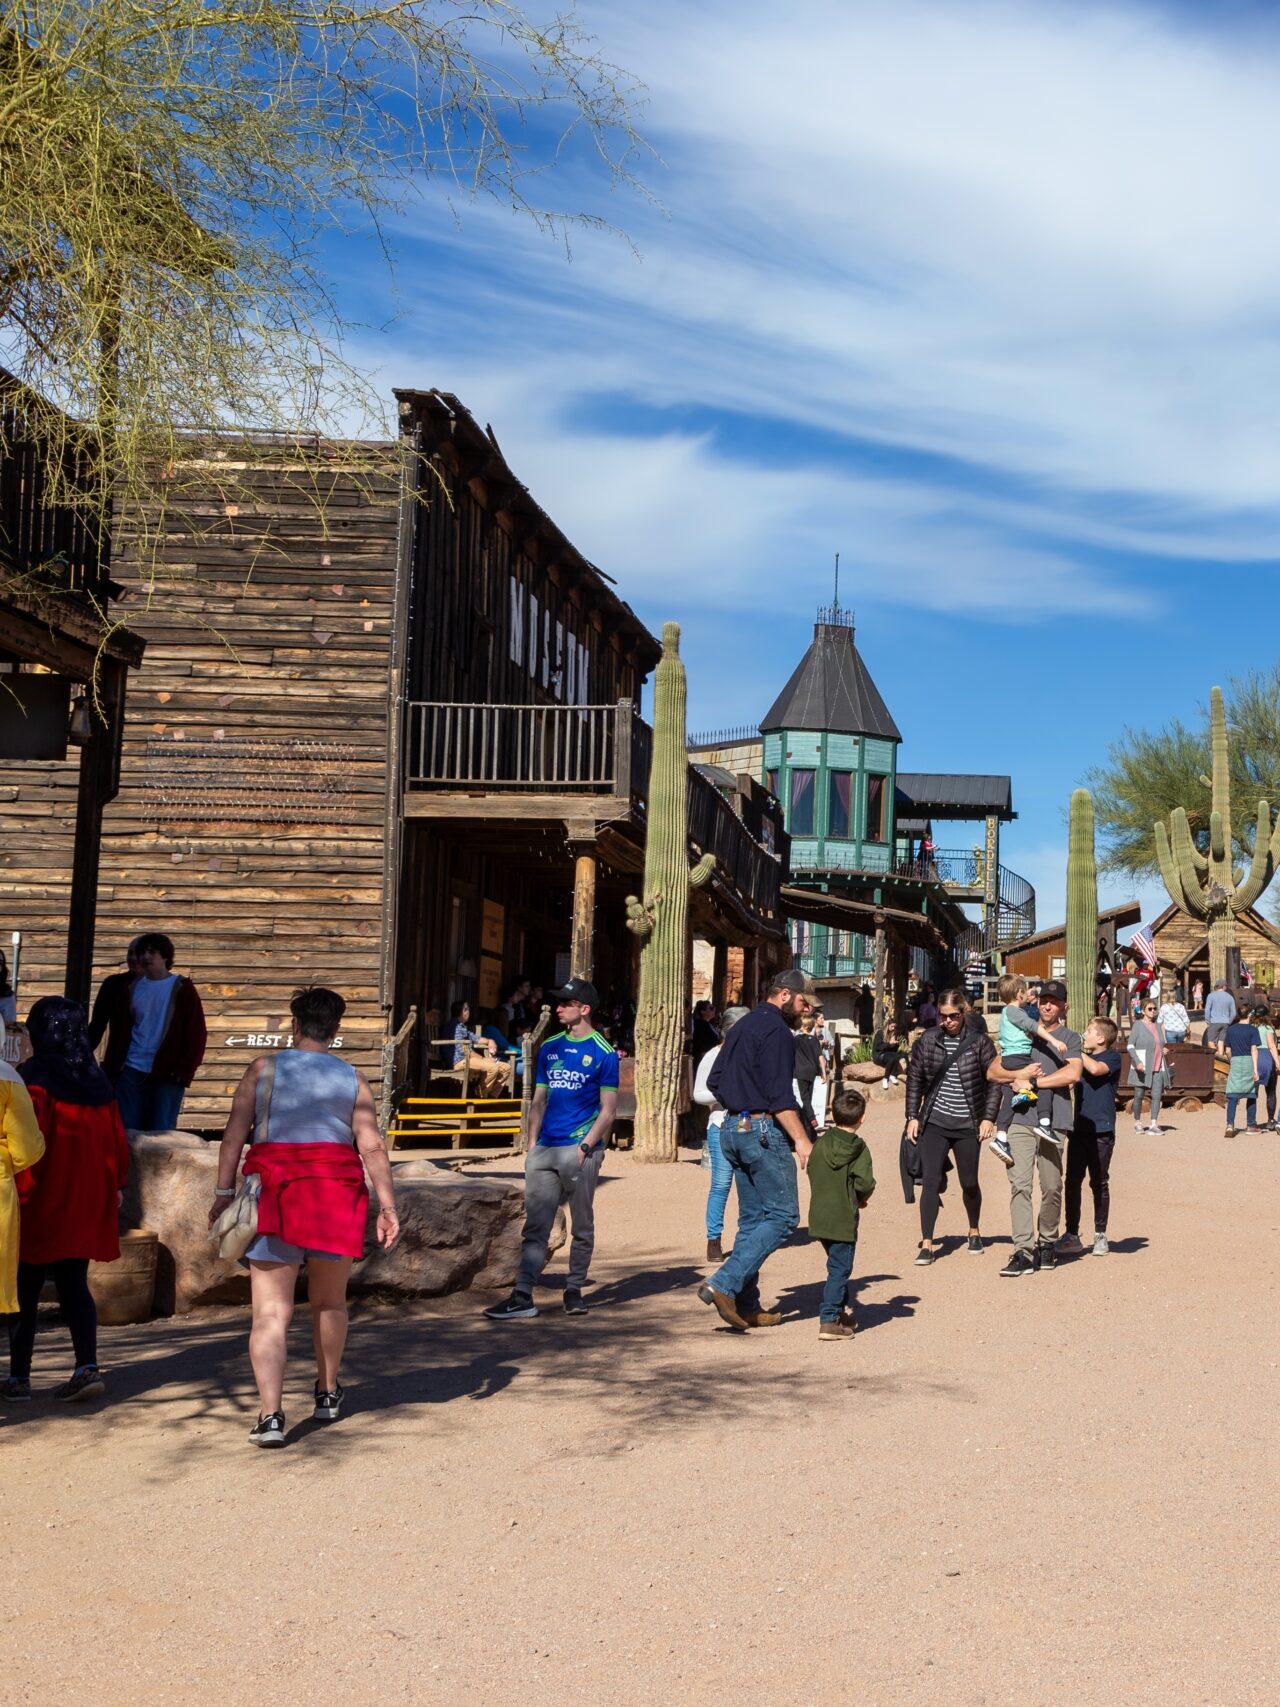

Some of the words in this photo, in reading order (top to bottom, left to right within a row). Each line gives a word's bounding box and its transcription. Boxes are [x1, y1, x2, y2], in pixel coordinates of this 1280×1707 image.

[510, 575, 589, 722] MUSEUM
[986, 818, 996, 901] BORDELLO
[247, 1034, 282, 1047] REST
[546, 1069, 590, 1083] KERRY
[549, 1080, 582, 1090] GROUP
